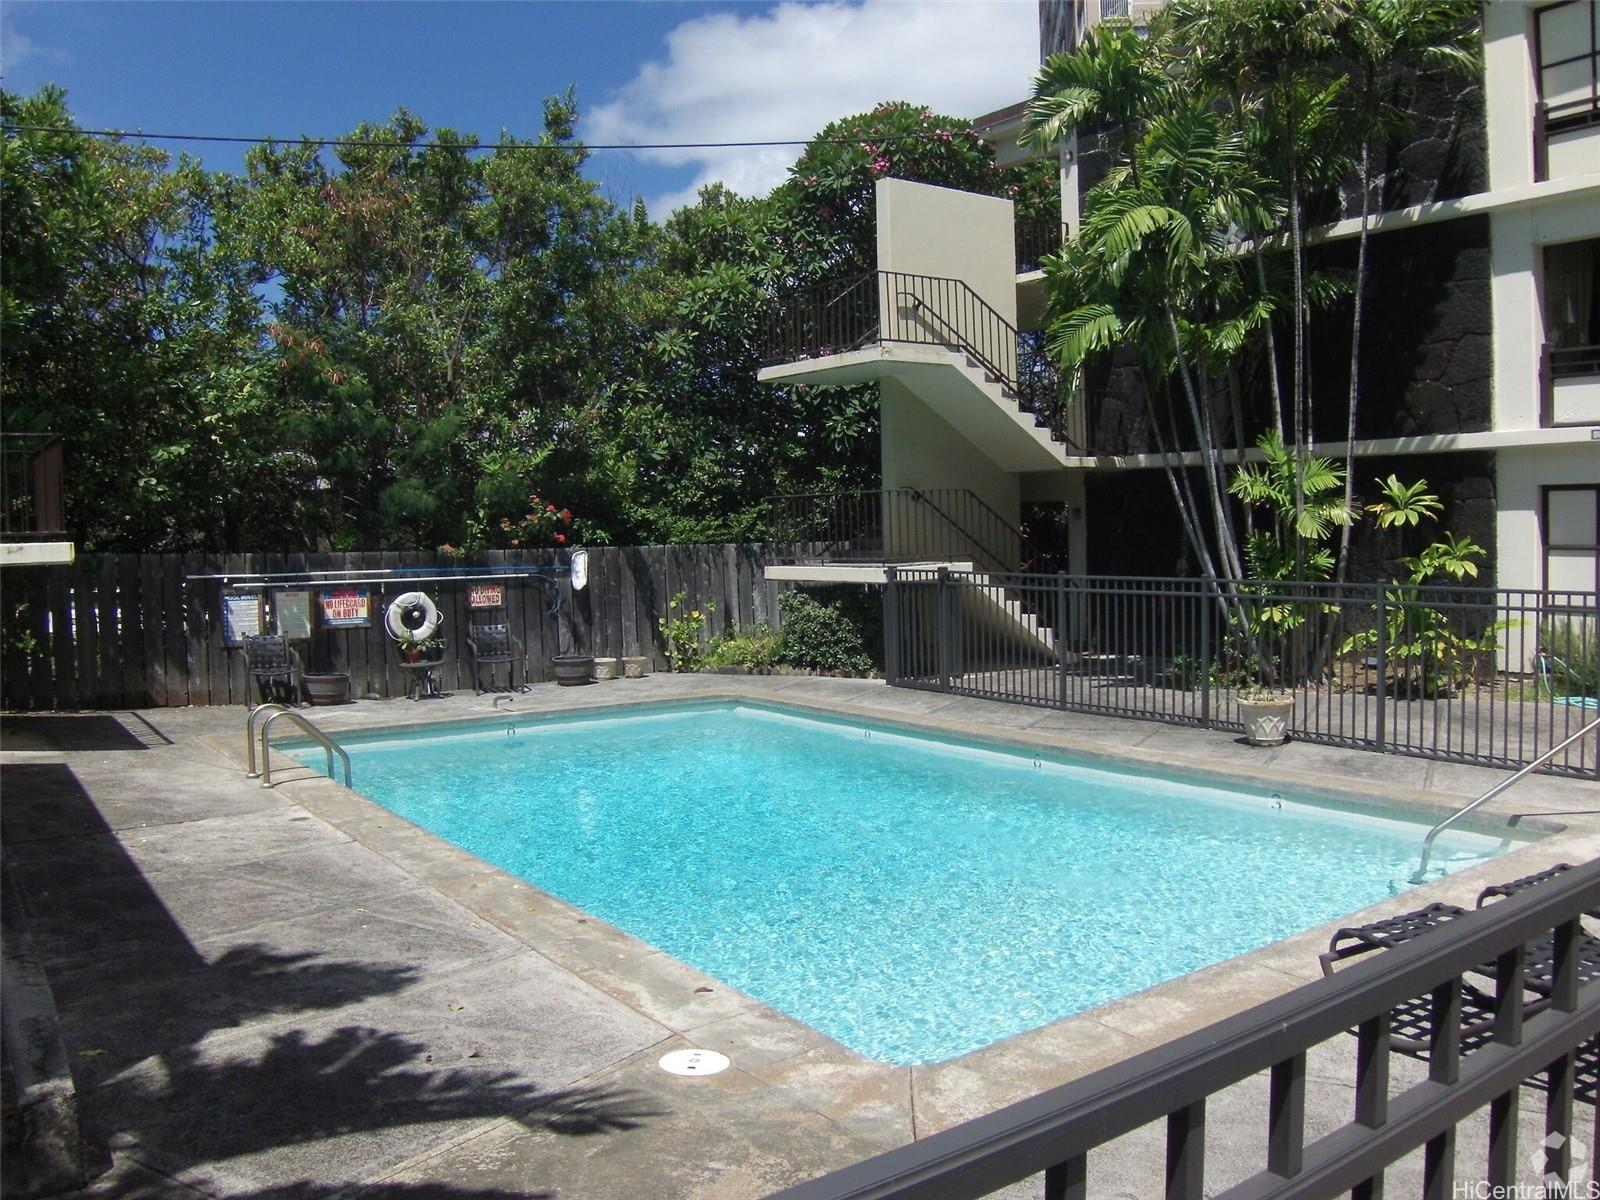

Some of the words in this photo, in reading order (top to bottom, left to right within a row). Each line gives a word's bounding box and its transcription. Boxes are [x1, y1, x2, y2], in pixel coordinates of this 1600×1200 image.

[325, 600, 334, 609] NO
[334, 598, 365, 609] LIFEGUARD
[471, 594, 500, 604] ALLOWED
[333, 608, 341, 618] ON
[342, 608, 359, 617] DUTY
